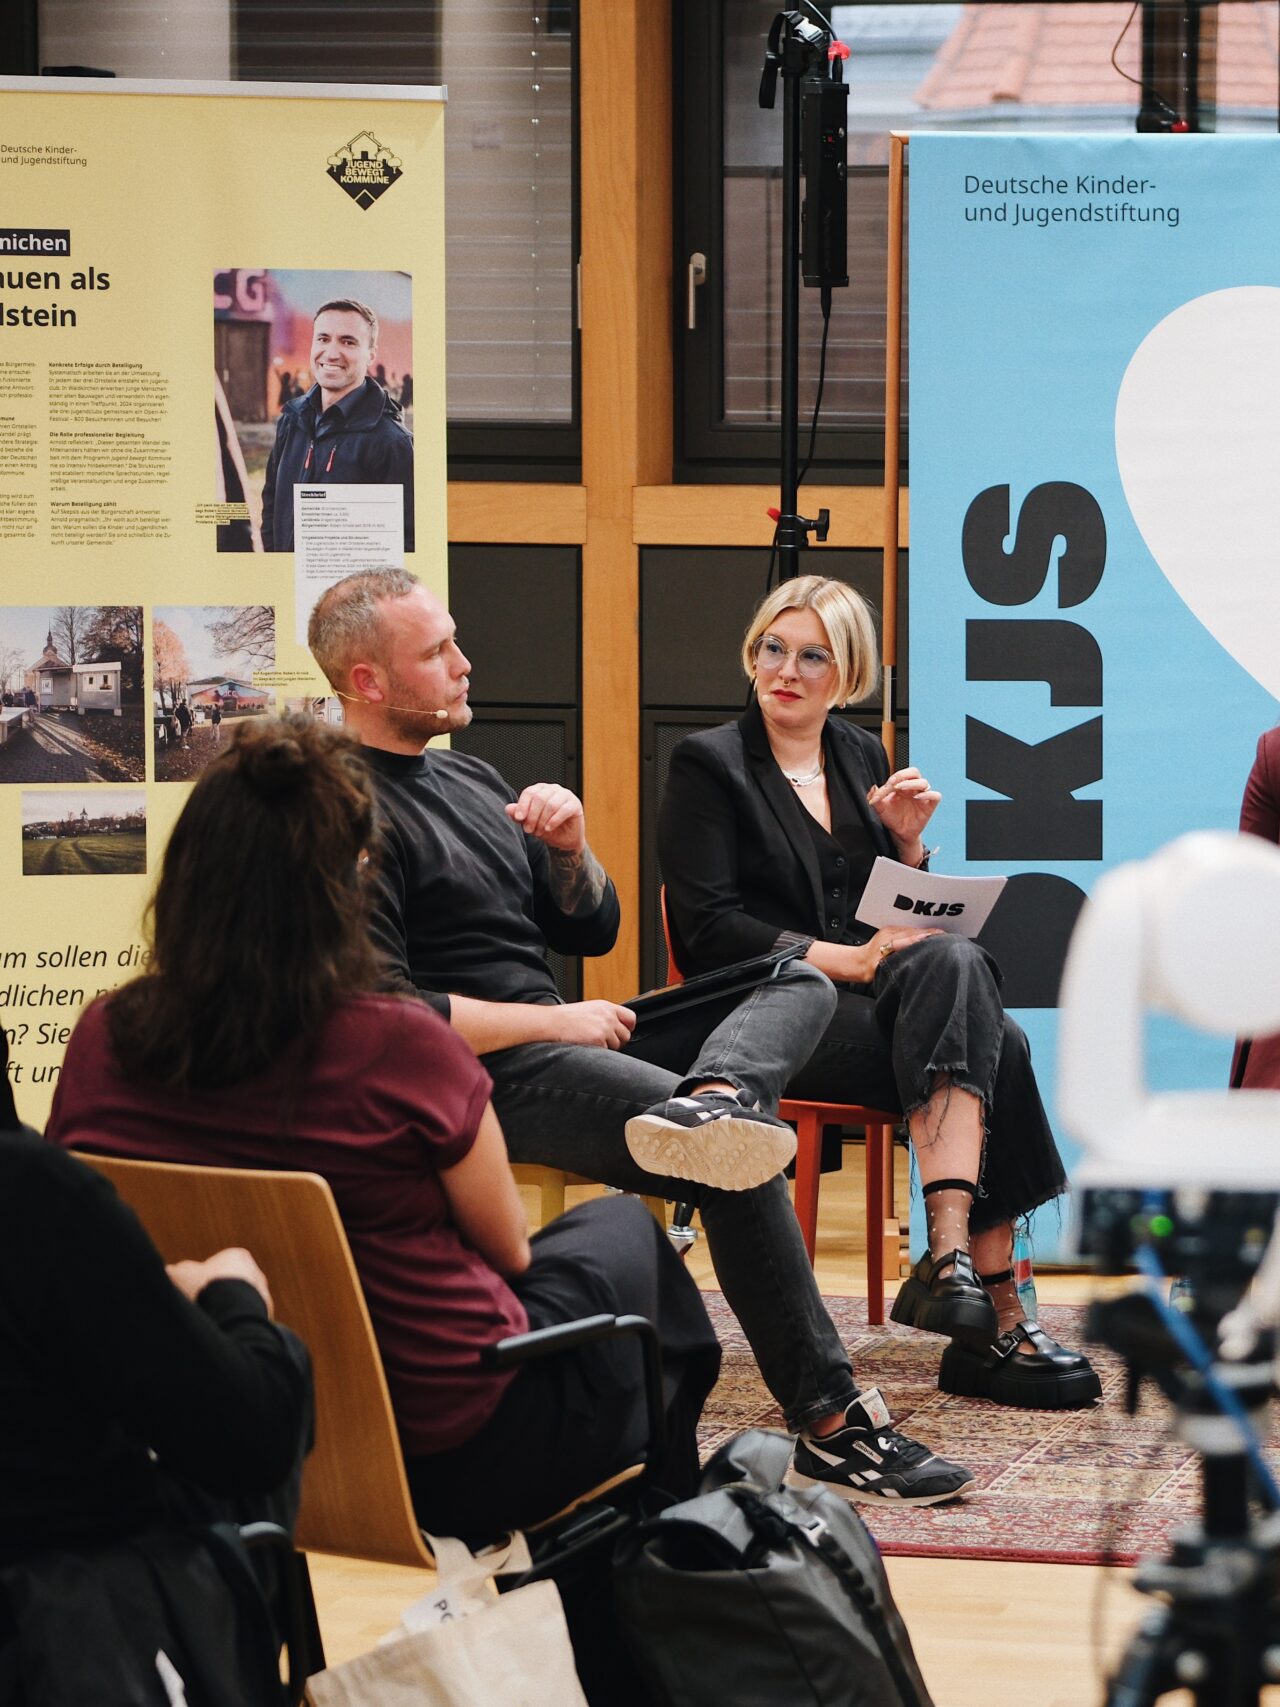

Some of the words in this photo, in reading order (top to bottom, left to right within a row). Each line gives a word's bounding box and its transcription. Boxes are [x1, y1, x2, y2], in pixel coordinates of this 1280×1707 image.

[1, 144, 43, 154] Deutsche
[45, 146, 77, 154] Kinder-
[1, 156, 18, 164] und
[21, 156, 87, 166] Jugendstiftung
[340, 176, 389, 184] KOMMUNE
[964, 175, 1068, 194] Deutsche
[1076, 175, 1156, 194] Kinder-
[964, 203, 1007, 222] und
[1012, 203, 1180, 227] Jugendstiftung
[71, 267, 110, 290] als
[962, 480, 1106, 1008] DKJS
[894, 894, 964, 916] DKJS
[36, 945, 107, 968] sollen
[36, 1023, 71, 1045] Sie
